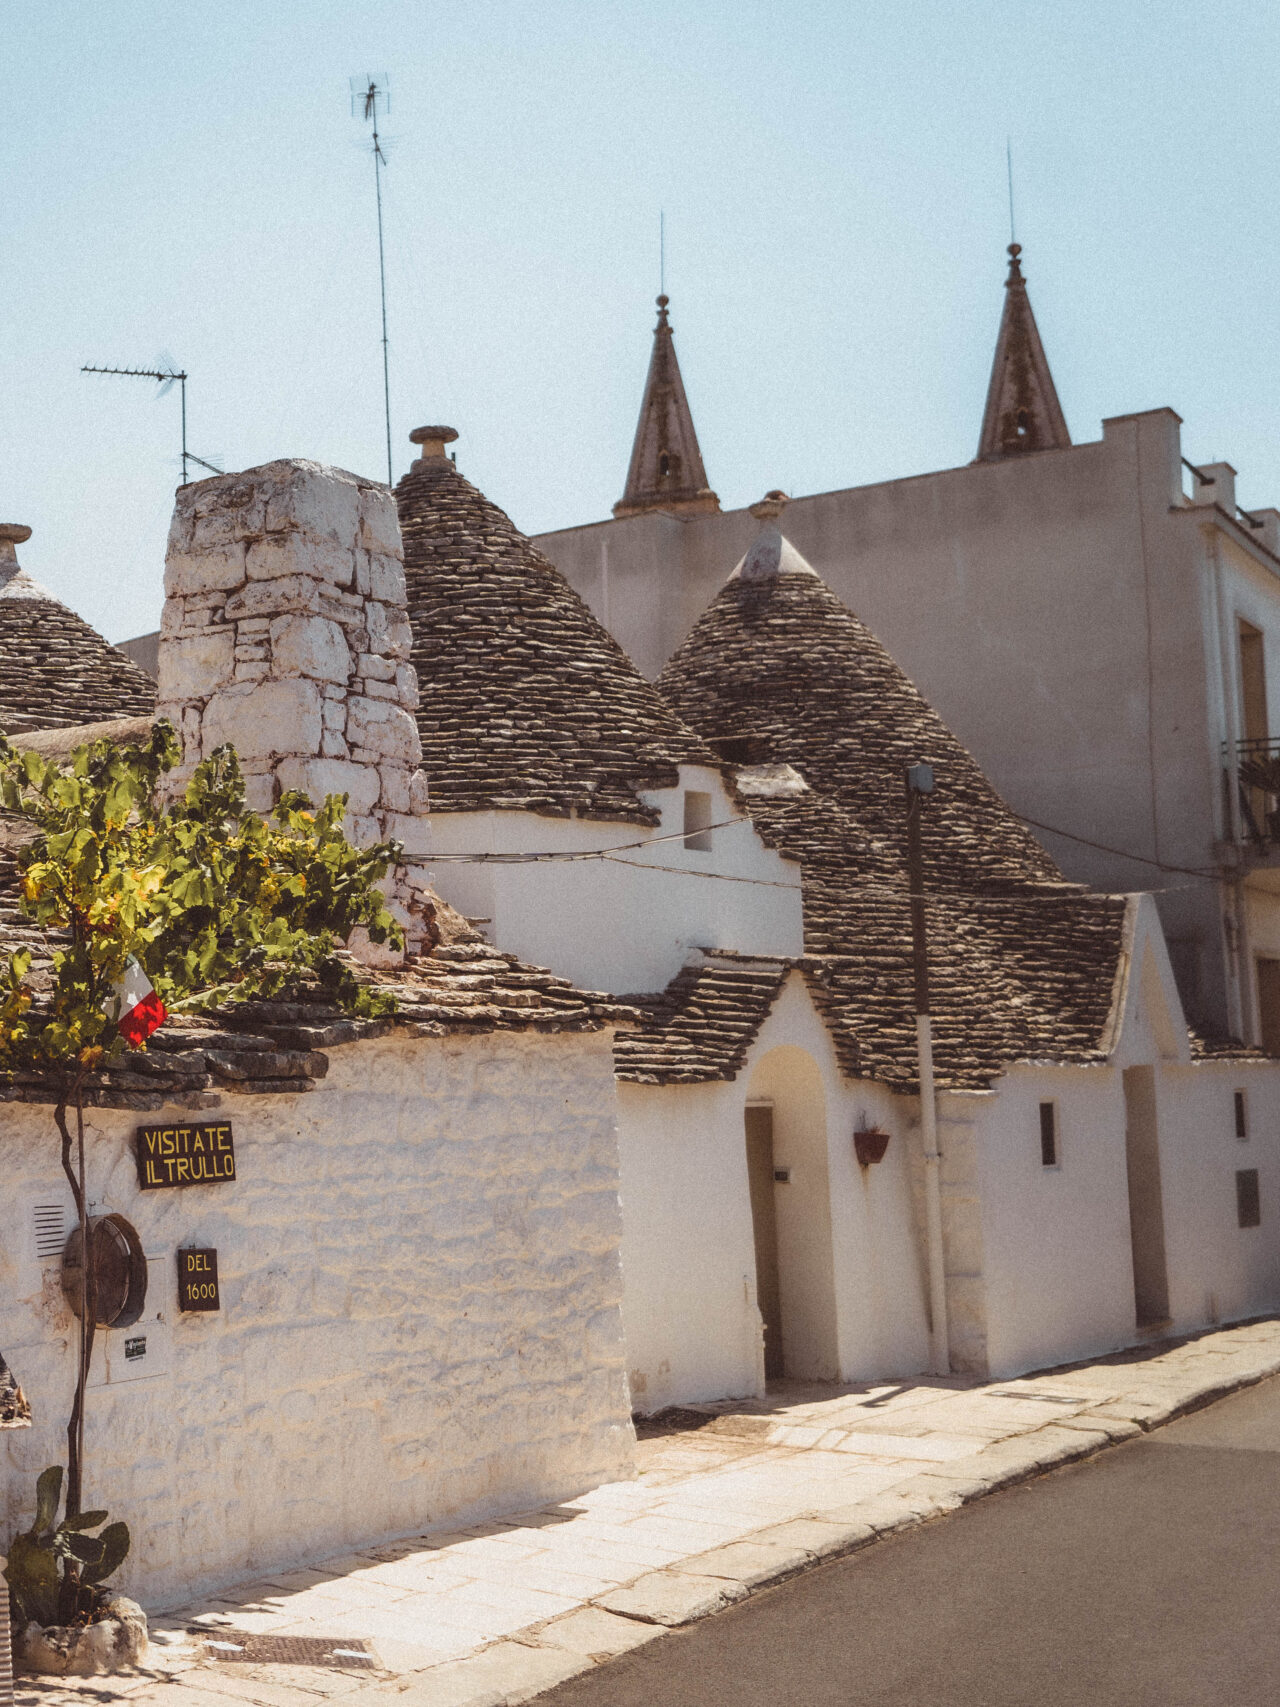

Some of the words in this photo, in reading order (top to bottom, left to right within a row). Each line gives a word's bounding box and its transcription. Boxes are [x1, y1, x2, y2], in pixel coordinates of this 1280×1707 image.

[145, 1127, 231, 1155] VISITATE
[146, 1160, 163, 1184] IL
[163, 1154, 234, 1182] TRULLO
[187, 1254, 212, 1272] DEL
[186, 1283, 216, 1300] 1600
